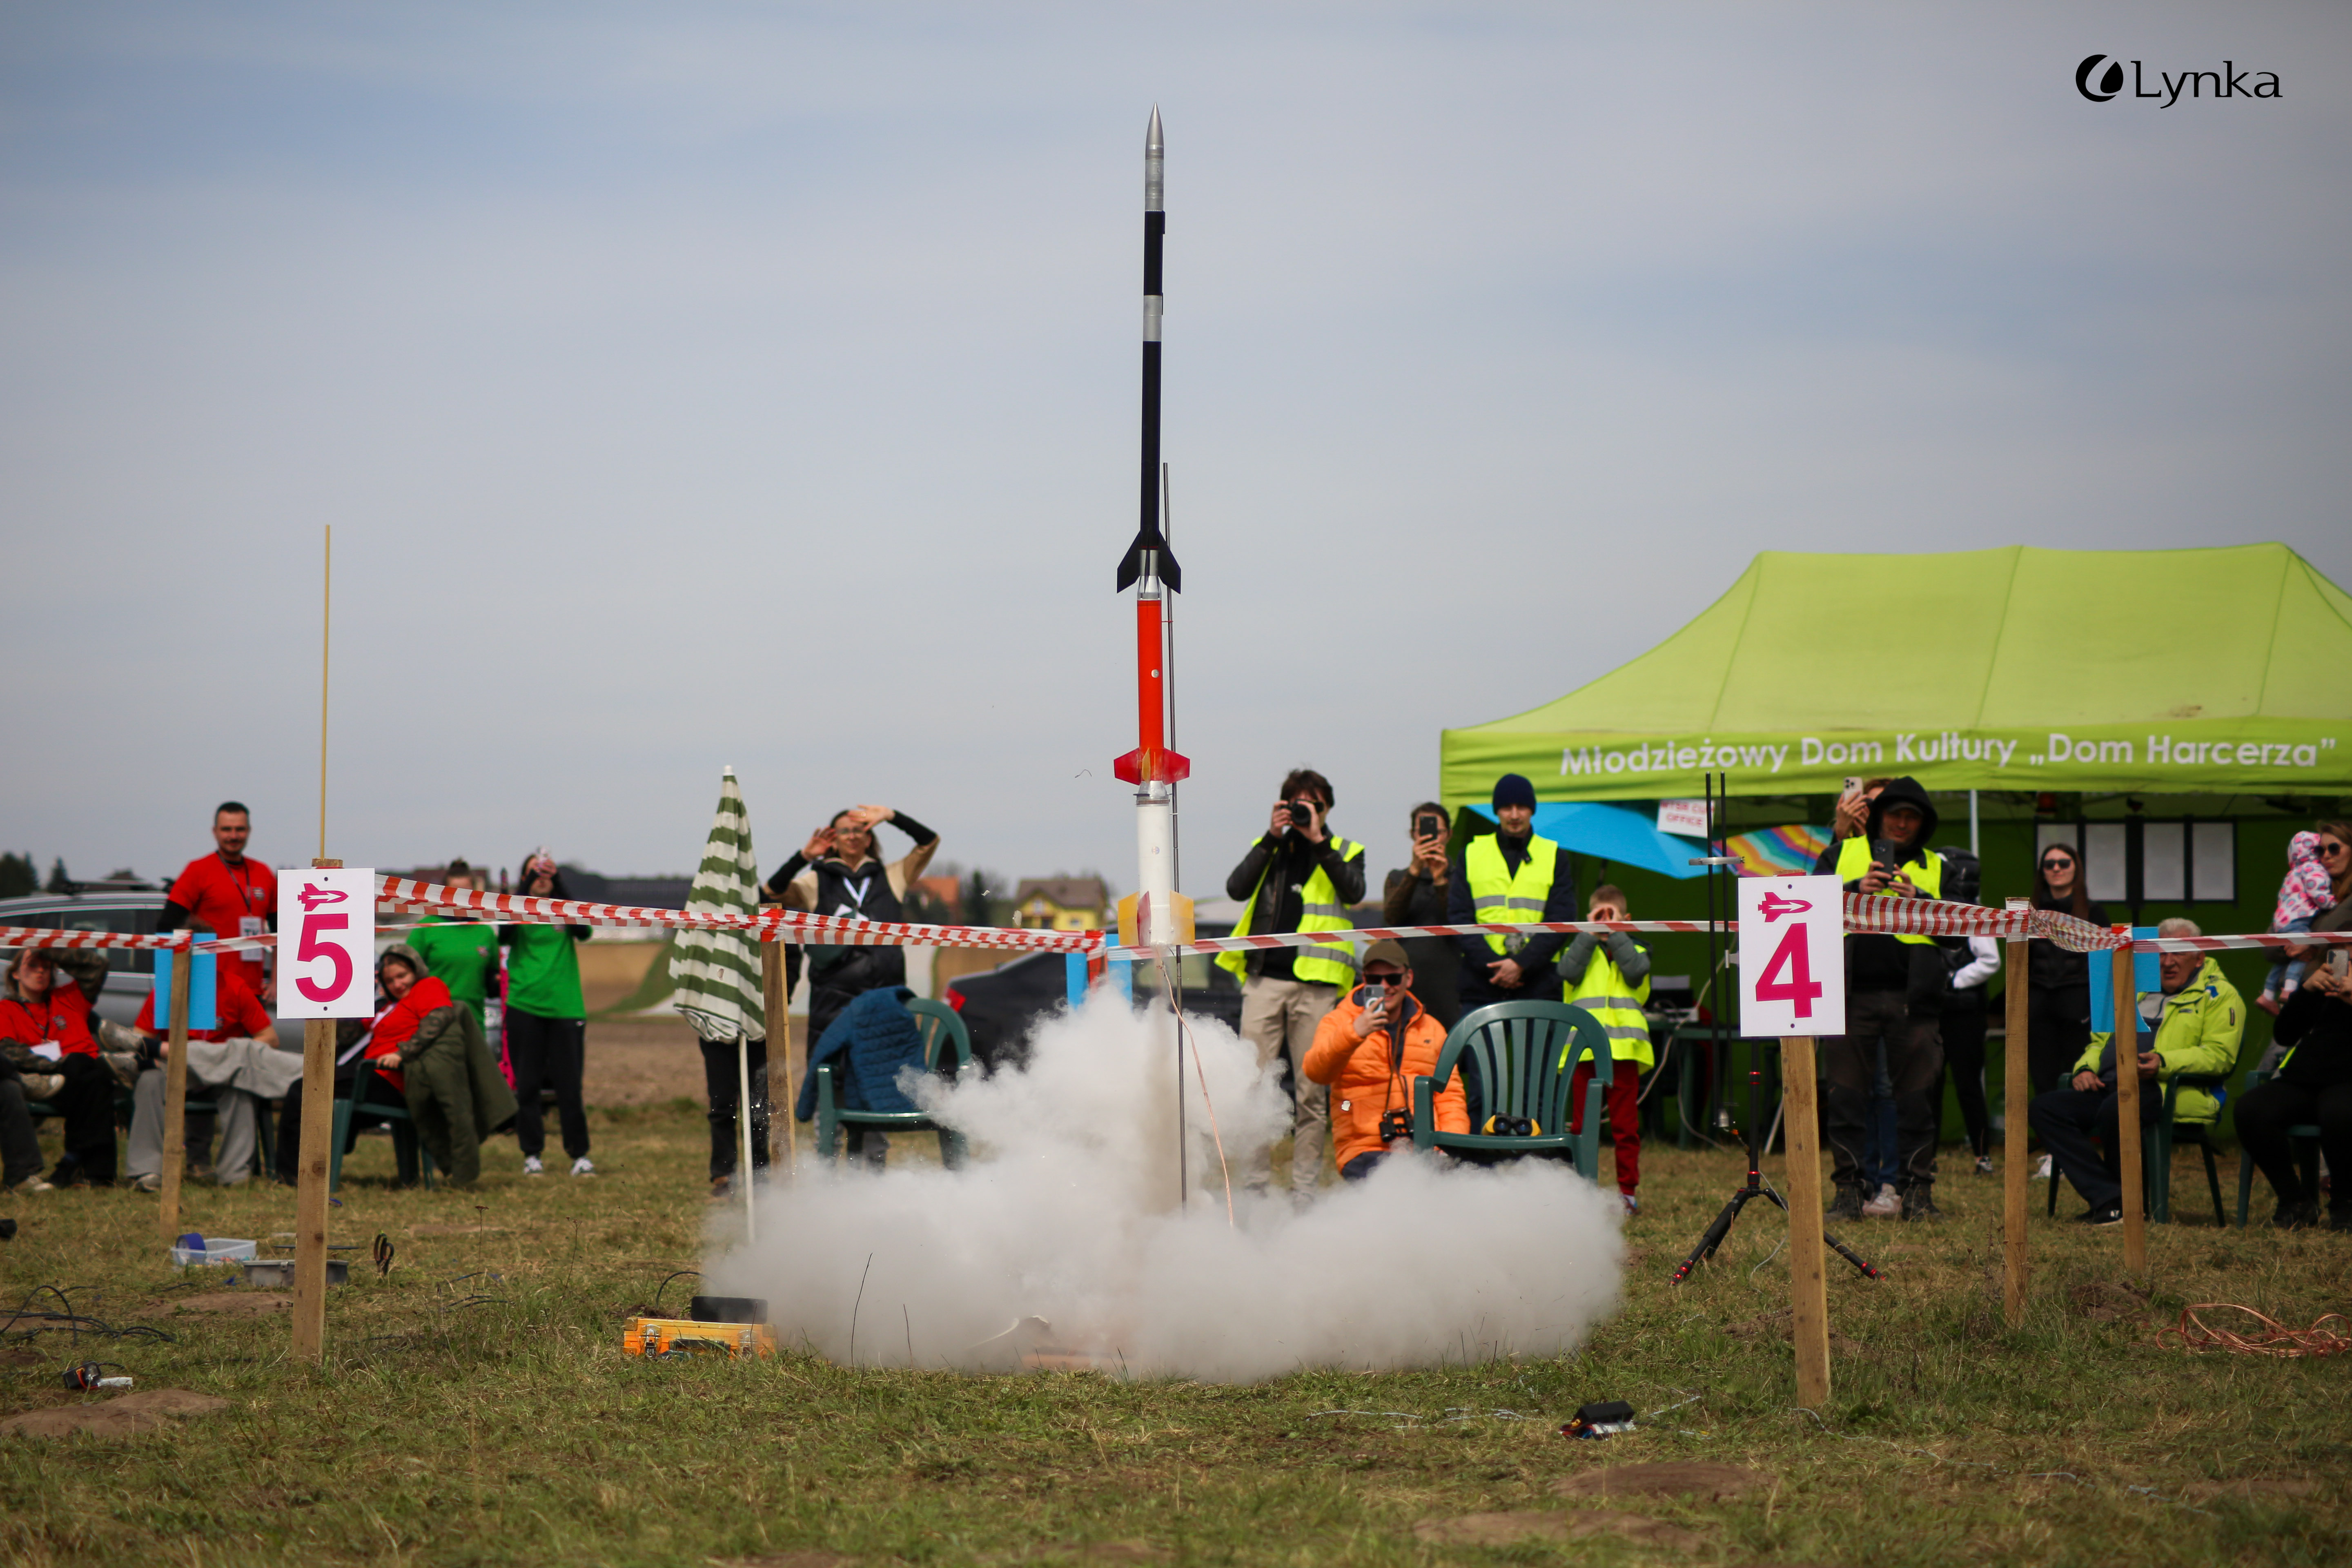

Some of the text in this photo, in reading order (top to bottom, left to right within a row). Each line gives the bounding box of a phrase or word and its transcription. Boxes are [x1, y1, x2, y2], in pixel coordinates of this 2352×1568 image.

[1560, 738, 1789, 775] Młodzieżowy
[1801, 737, 1883, 765] Dom
[1896, 732, 2018, 768] Kultury
[295, 913, 353, 1002] 5
[1755, 922, 1823, 1018] 4
